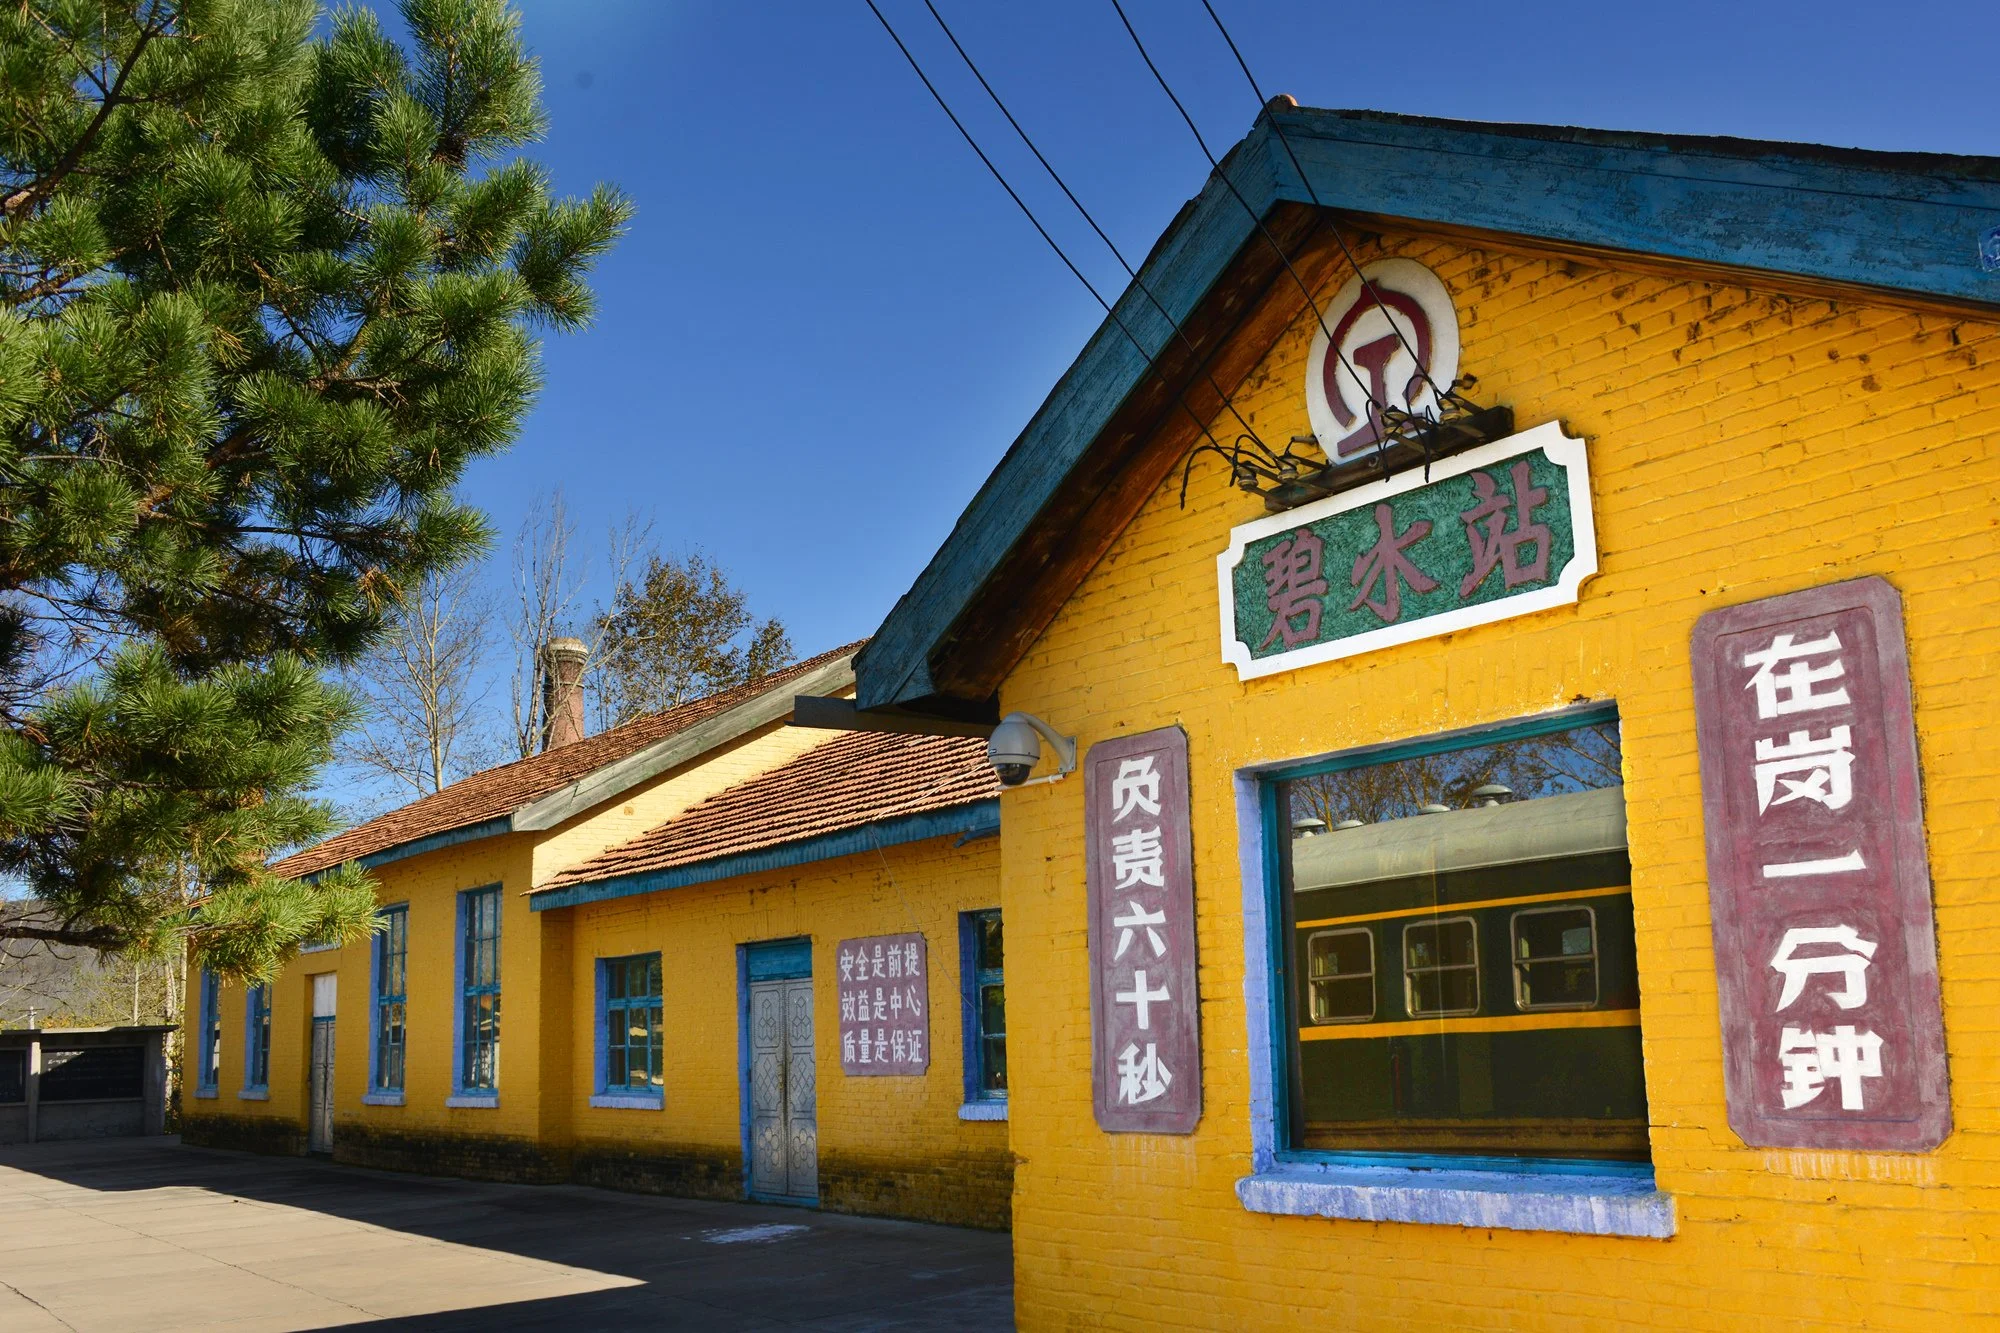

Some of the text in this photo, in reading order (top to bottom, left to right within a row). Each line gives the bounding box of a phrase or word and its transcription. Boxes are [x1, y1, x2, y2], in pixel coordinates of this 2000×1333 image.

[1259, 461, 1552, 652] 碧水站
[1744, 630, 1884, 1111] 在岗一分钟
[840, 943, 920, 982] 安全是前提
[1112, 756, 1173, 1105] 负责六十秒
[841, 984, 921, 1022] 效益是中心
[843, 1028, 922, 1063] 质量是保证
